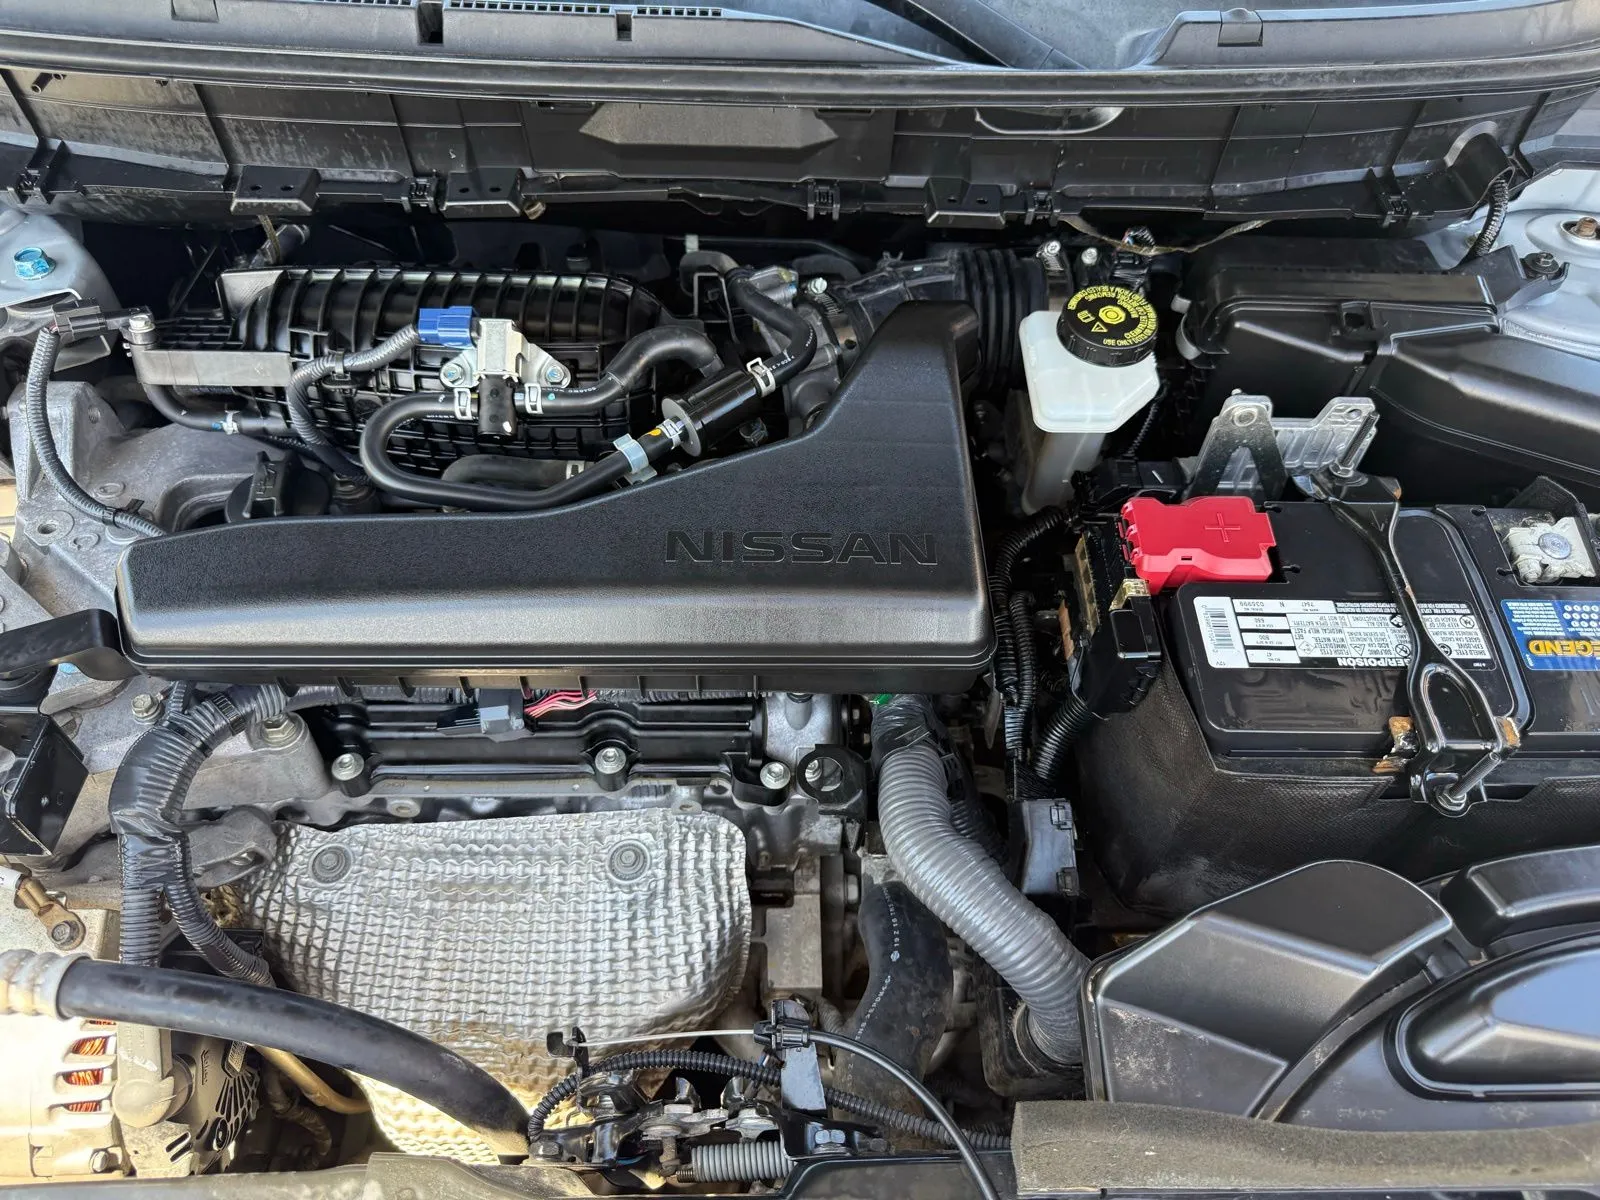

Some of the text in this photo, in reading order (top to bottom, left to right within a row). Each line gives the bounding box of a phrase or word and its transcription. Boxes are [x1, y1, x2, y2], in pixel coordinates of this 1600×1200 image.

[665, 530, 938, 566] NISSAN
[1528, 640, 1600, 656] GEND
[1337, 658, 1410, 666] GER/POISON
